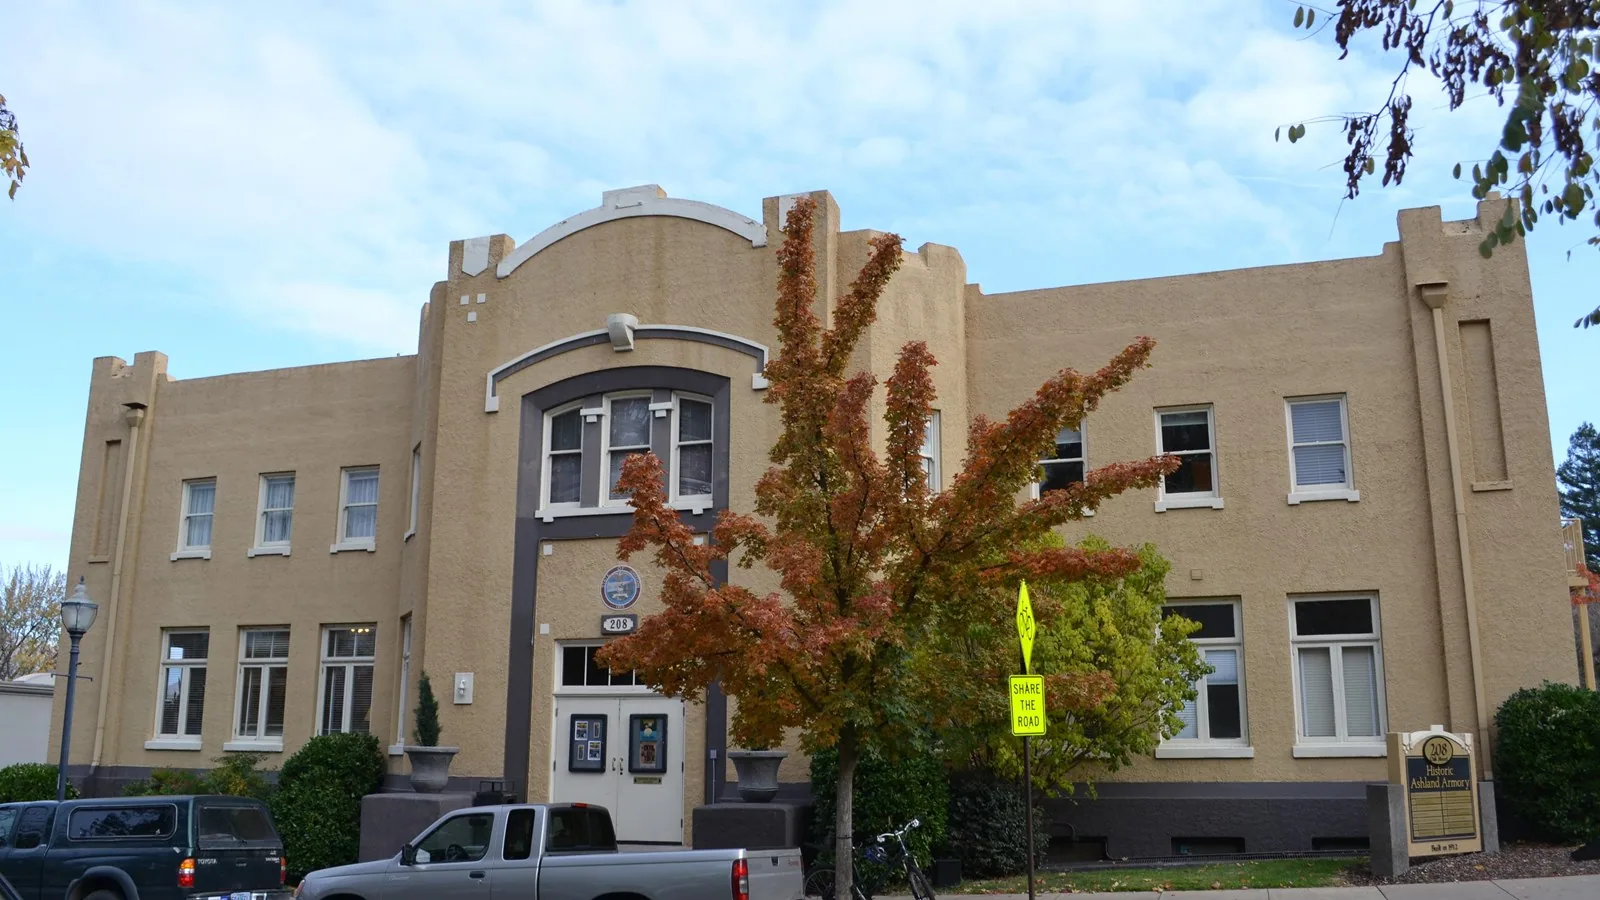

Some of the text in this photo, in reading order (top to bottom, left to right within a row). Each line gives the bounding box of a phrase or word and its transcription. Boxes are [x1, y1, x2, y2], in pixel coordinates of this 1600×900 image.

[610, 619, 628, 629] 208
[1013, 683, 1040, 694] SHARE
[1020, 700, 1036, 710] THE
[1017, 716, 1040, 727] ROAD
[1431, 743, 1448, 756] 208
[1426, 764, 1454, 776] Historic
[1411, 776, 1470, 790] Ashland Armory
